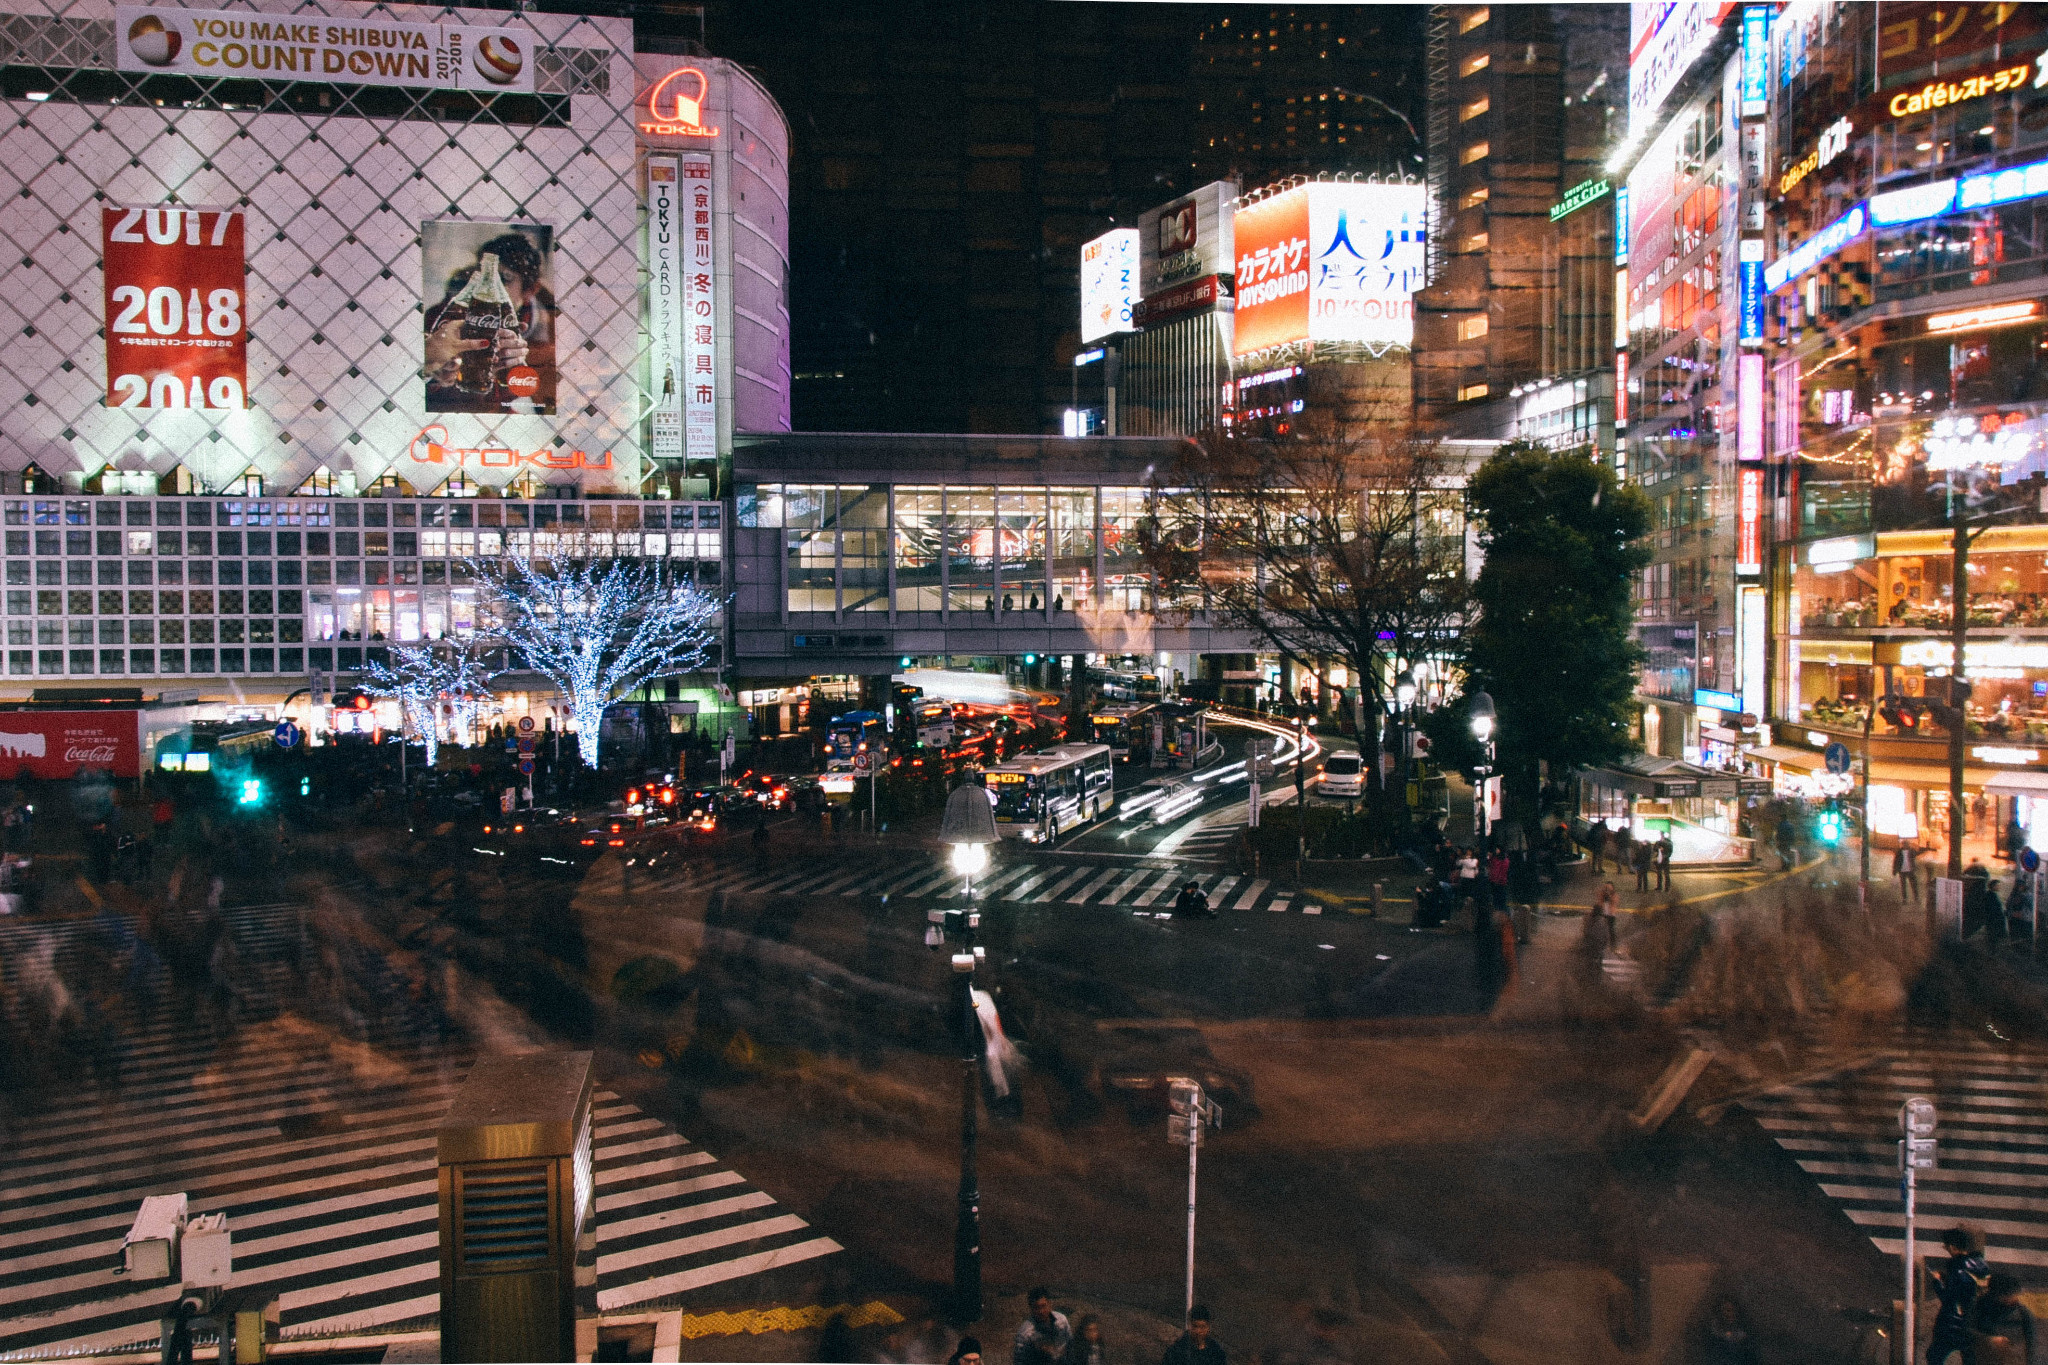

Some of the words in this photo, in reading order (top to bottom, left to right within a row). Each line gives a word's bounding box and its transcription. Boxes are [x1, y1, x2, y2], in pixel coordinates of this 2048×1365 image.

[192, 18, 245, 39] YOU
[250, 22, 320, 45] MAKE
[326, 26, 429, 50] SHIBUYA
[449, 33, 463, 66] 2018
[191, 42, 317, 74] COUNT
[323, 49, 430, 79] DOWN
[436, 48, 450, 80] 2017
[638, 122, 719, 137] TOKYU
[1550, 195, 1580, 218] MARK
[1581, 179, 1608, 201] CITY
[1563, 179, 1593, 200] SHIBUYA
[1746, 149, 1759, 217] 献血ルーム
[110, 207, 234, 247] 2017
[657, 185, 670, 244] TOKYU
[658, 247, 671, 296] CARD
[1237, 236, 1307, 287] カラオケ
[1237, 269, 1309, 311] JOYSOUND
[111, 285, 242, 337] 2018
[694, 272, 713, 405] 冬の寝具市
[113, 373, 244, 410] 2019
[453, 448, 613, 470] TOKYU
[64, 745, 117, 762] Coca-Cola
